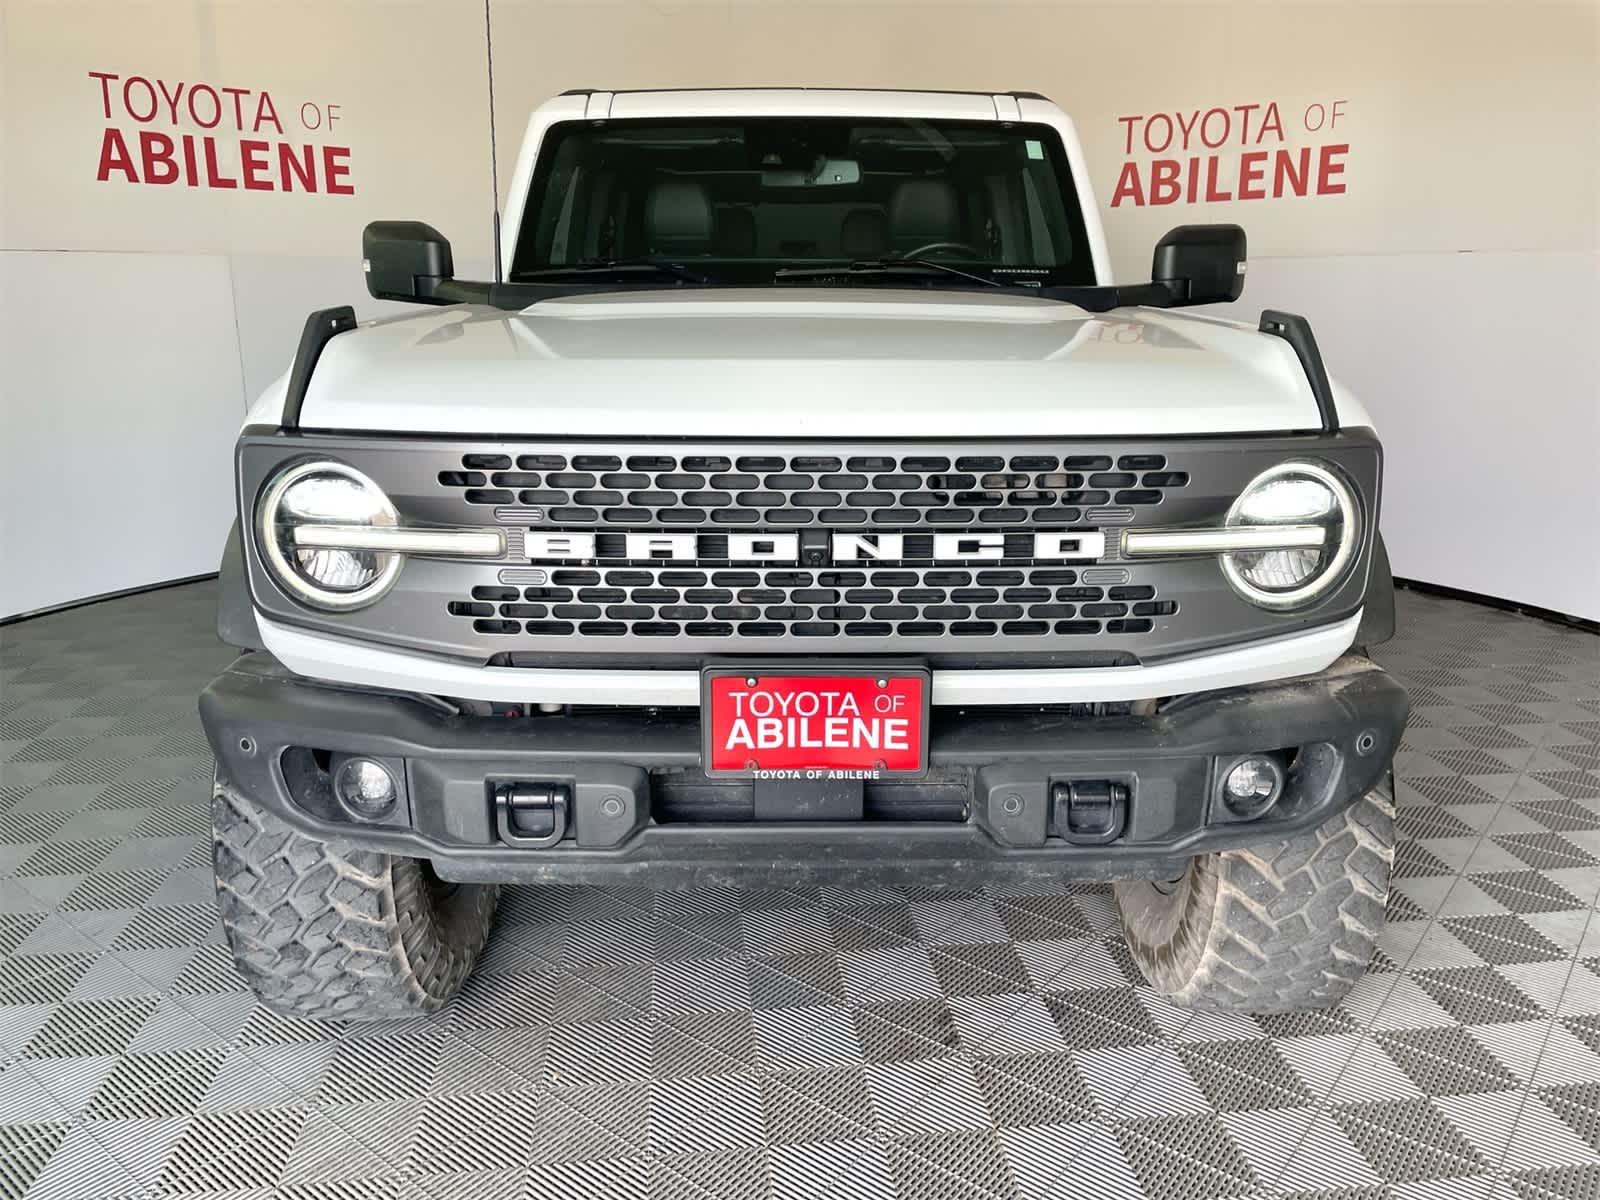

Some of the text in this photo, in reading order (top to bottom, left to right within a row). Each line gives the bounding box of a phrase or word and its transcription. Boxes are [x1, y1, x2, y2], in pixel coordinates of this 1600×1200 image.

[88, 71, 342, 134] TOYOTA OF
[1118, 99, 1349, 155] TOYOTA OF
[96, 127, 355, 196] ABILENE
[1110, 143, 1350, 209] ABILENE
[523, 531, 1106, 562] BRONCO
[727, 691, 906, 718] TOYOTA OF
[724, 717, 910, 751] ABILENE
[752, 769, 881, 780] TOYOTA OF ABILENE
